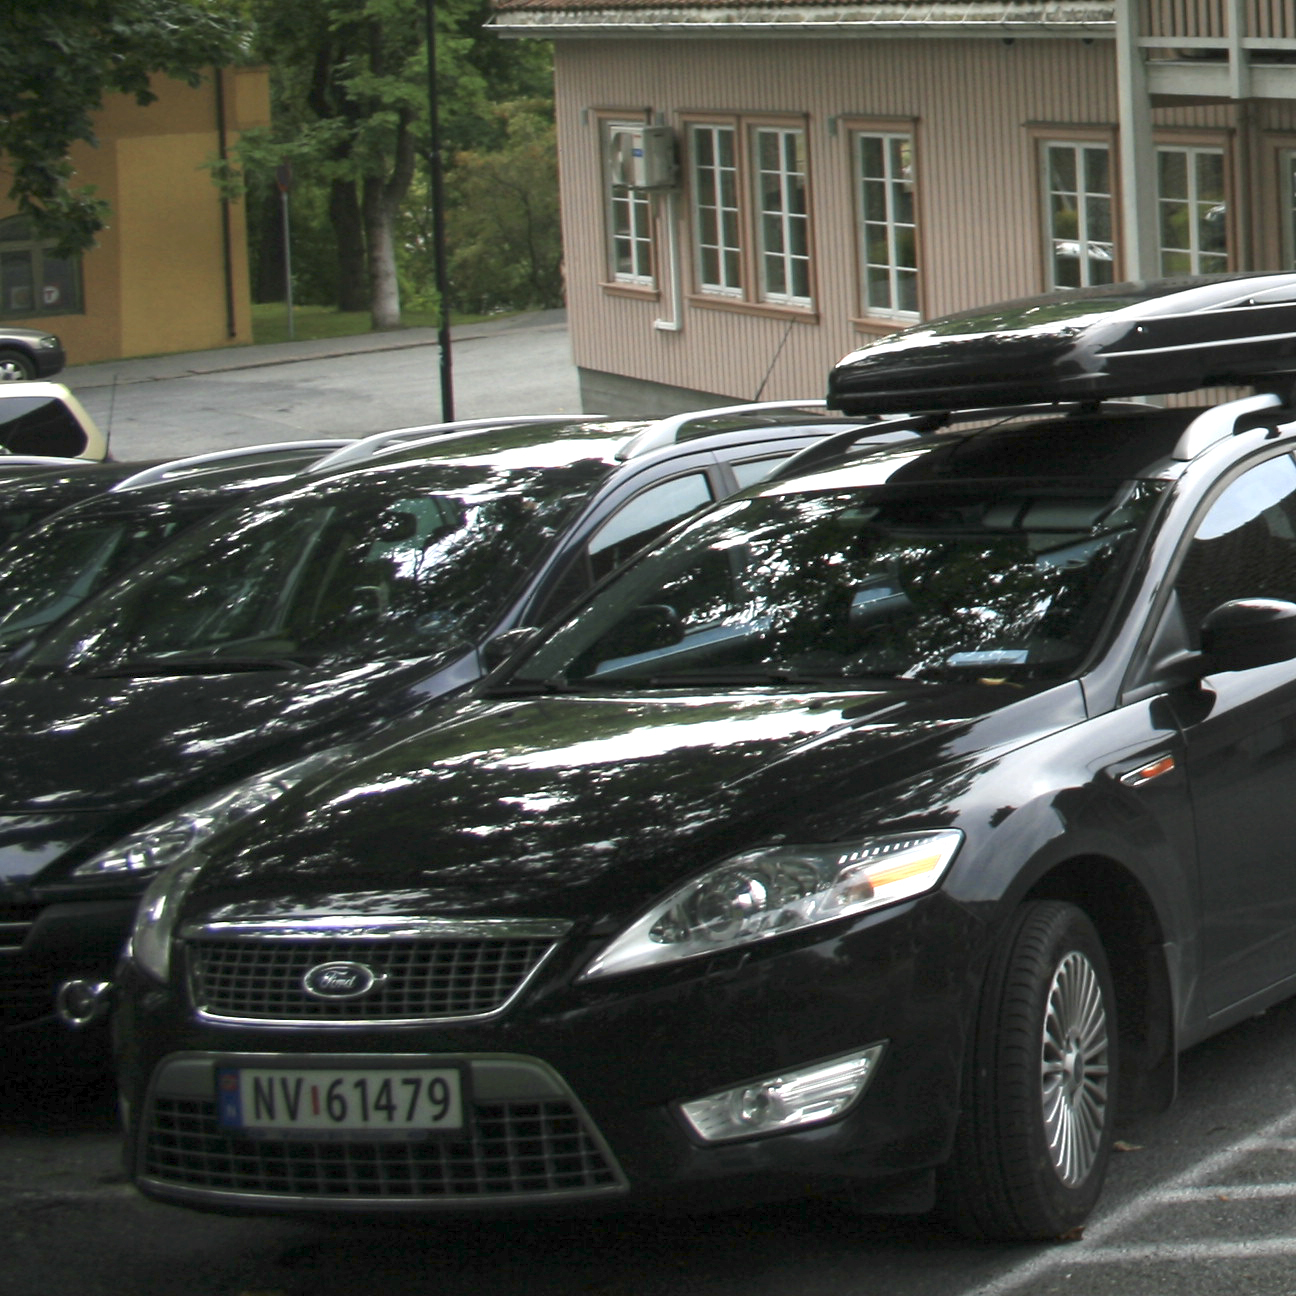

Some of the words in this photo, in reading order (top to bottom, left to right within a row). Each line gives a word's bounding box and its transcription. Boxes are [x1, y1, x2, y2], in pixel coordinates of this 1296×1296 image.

[321, 966, 357, 988] Ford
[254, 1076, 303, 1121] NV
[326, 1077, 450, 1122] 61479
